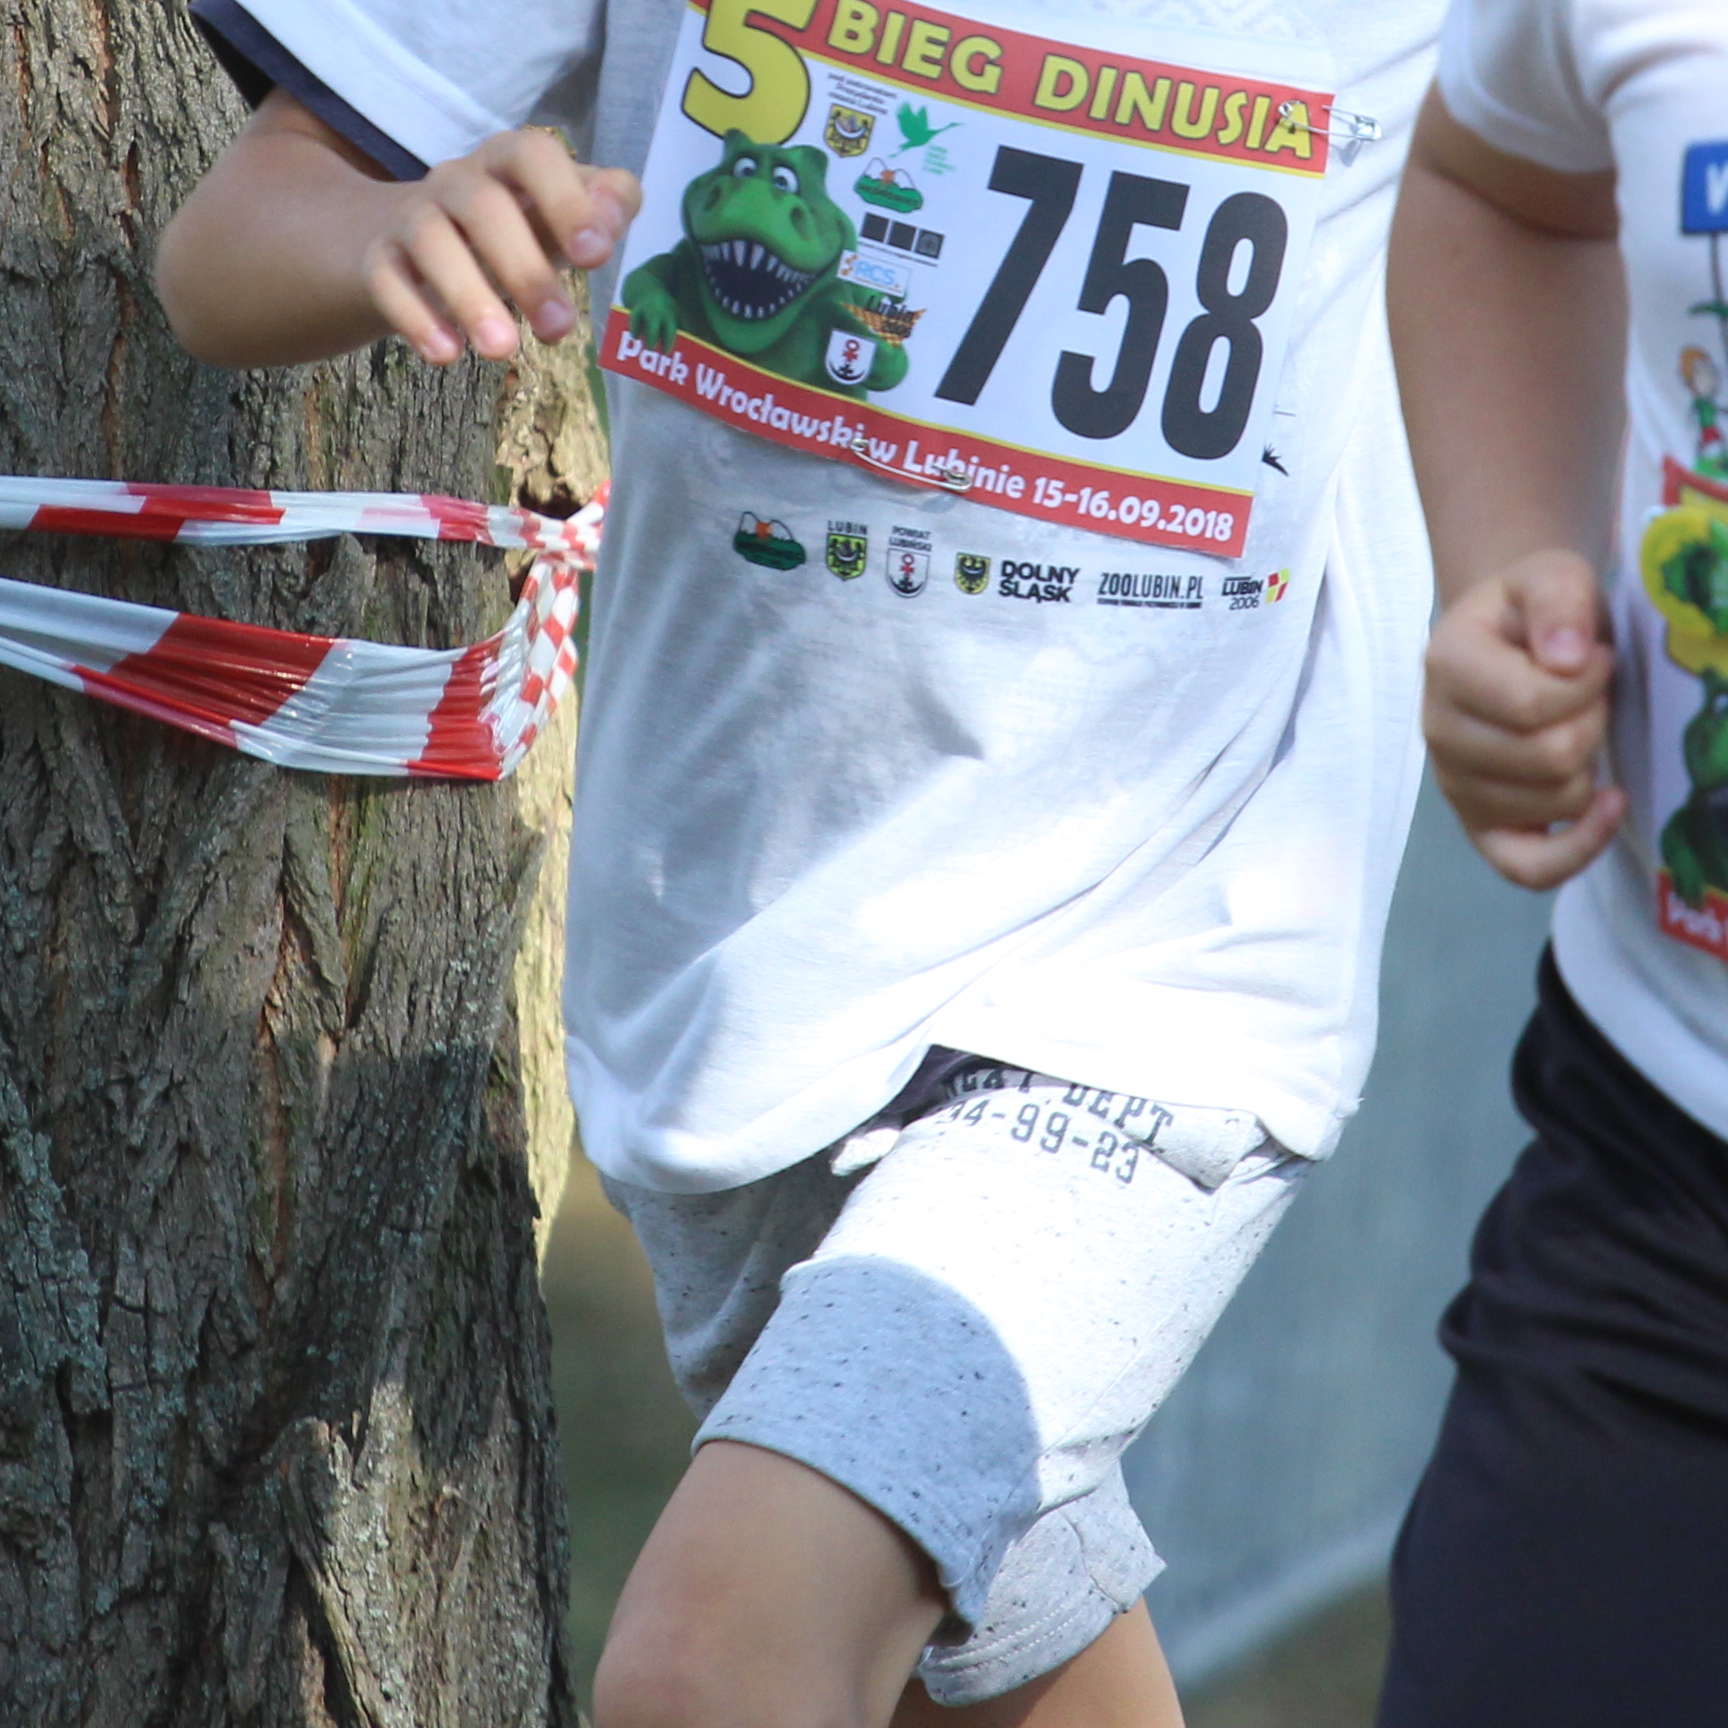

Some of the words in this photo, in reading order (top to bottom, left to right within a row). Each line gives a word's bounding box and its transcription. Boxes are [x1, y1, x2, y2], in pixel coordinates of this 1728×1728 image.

[1033, 52, 1313, 160] DINUSIA
[932, 143, 1289, 461] 758
[616, 330, 689, 386] Park
[694, 362, 864, 447] Wrocławski
[868, 437, 898, 464] w
[903, 440, 1026, 499] Lubinie
[1032, 475, 1236, 542] 15-16.09.2018
[827, 520, 869, 536] LUBIN
[892, 525, 932, 540] POWIAT
[1001, 559, 1080, 585] DOLNY
[998, 577, 1072, 604] ŚLĄSK
[1097, 572, 1204, 600] ZOOLUBIN.PL
[1221, 579, 1263, 598] LUBIN
[1228, 596, 1261, 611] 2006
